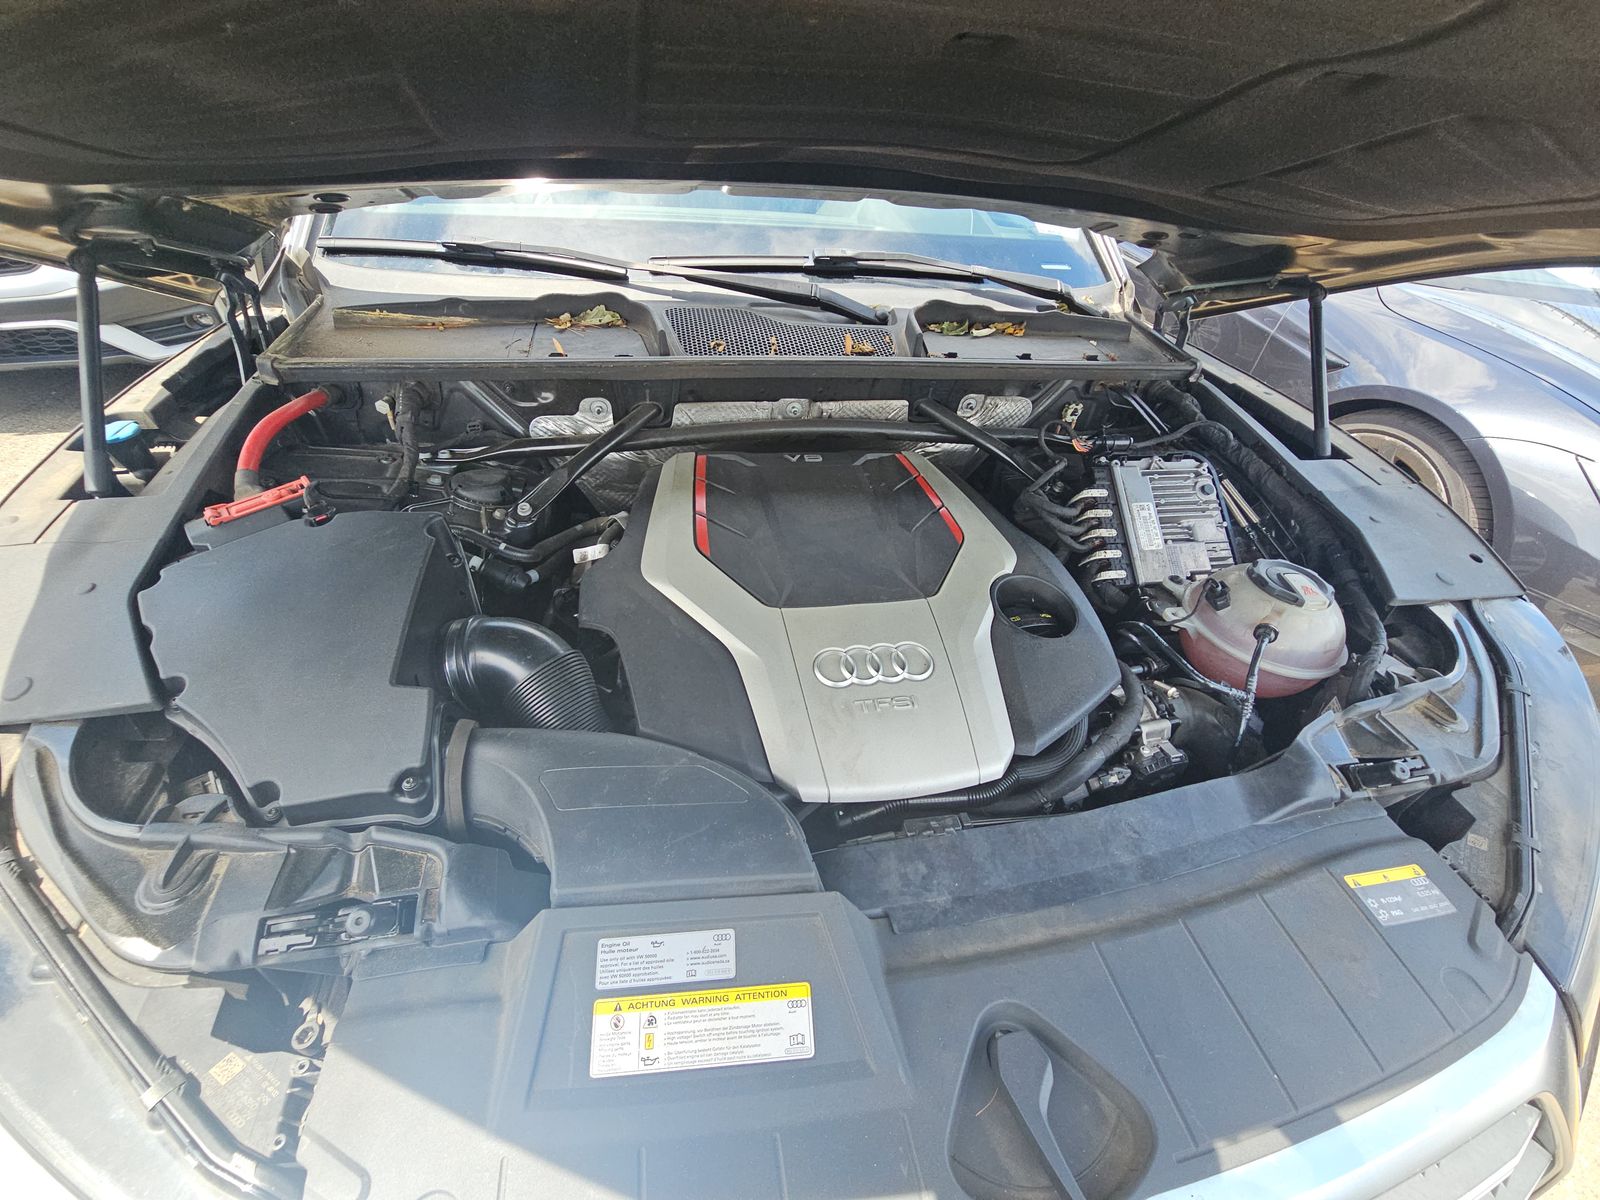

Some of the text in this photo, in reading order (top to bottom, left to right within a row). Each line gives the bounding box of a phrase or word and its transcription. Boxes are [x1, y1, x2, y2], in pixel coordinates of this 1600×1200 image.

[628, 990, 788, 1010] ACHTUNG WARNING ATTENTION
